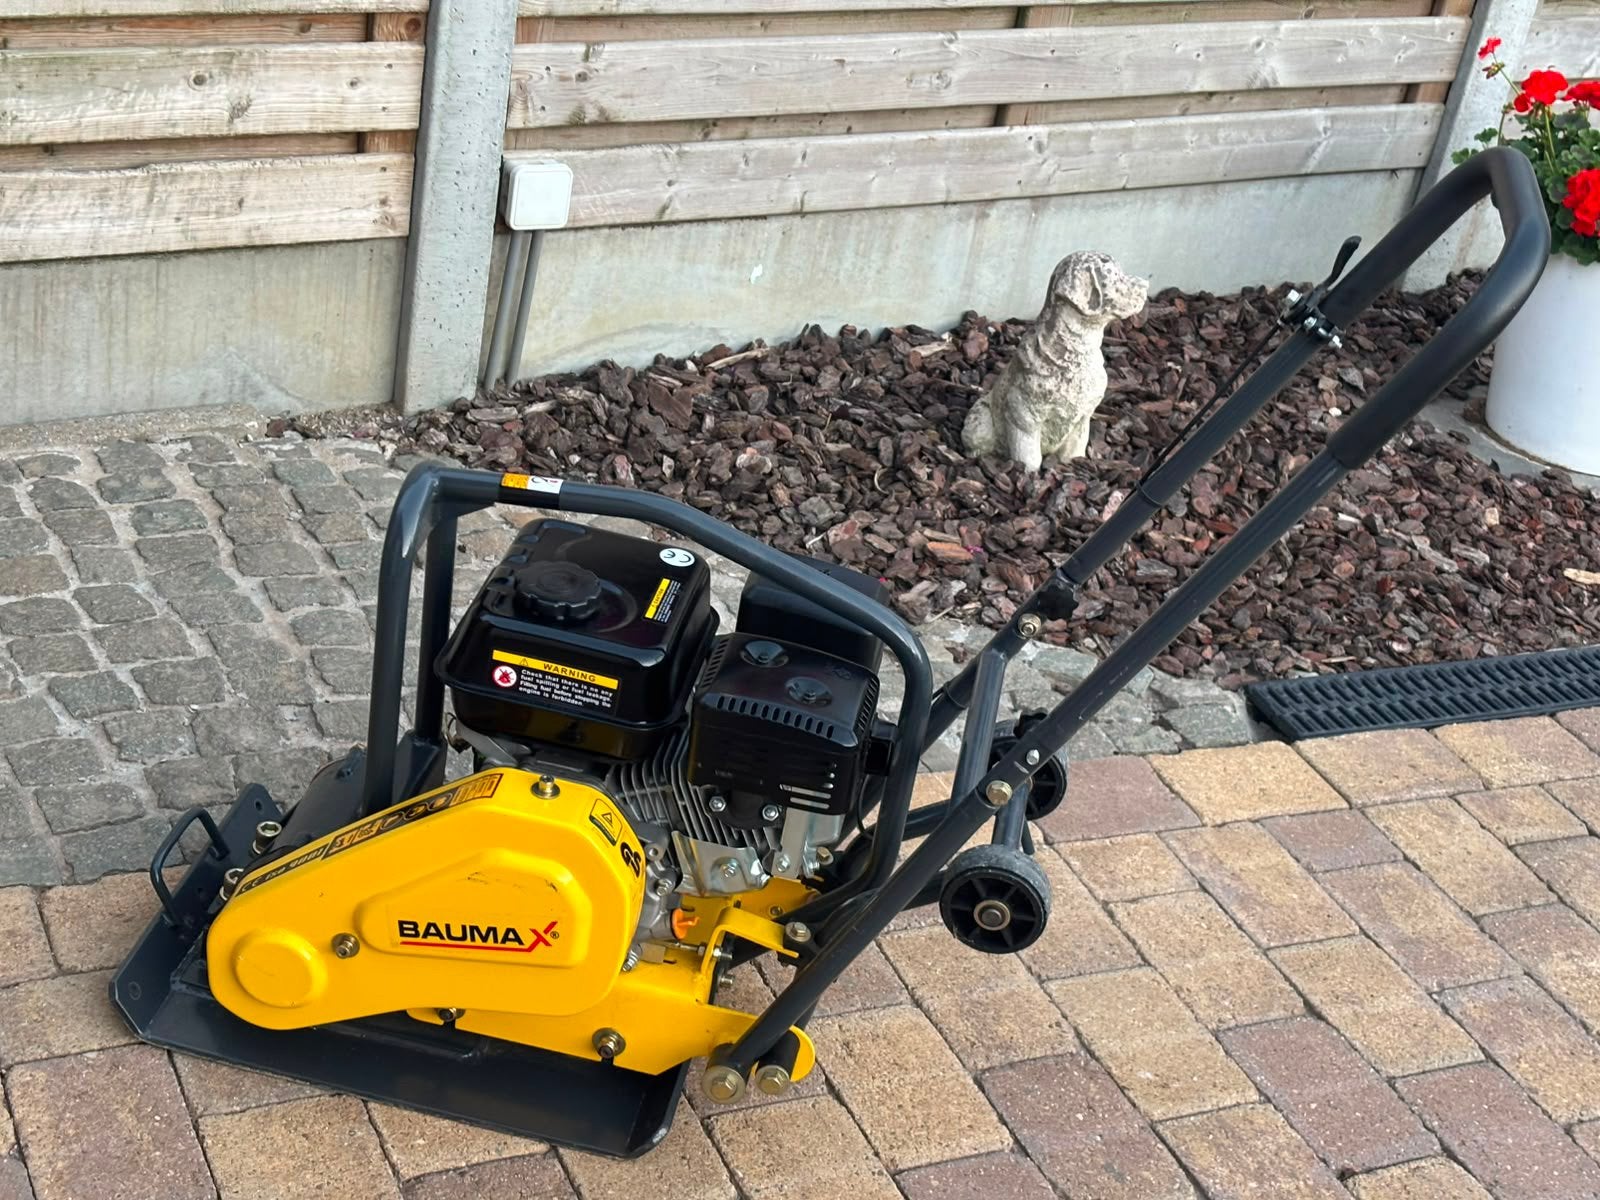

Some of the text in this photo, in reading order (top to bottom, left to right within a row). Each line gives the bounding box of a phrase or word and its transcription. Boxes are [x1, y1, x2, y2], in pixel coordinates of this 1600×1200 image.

[543, 663, 596, 682] WARNING
[518, 686, 541, 695] engine
[520, 680, 538, 690] Filling
[553, 688, 572, 698] before
[521, 669, 543, 678] Check
[545, 674, 559, 682] that
[561, 679, 579, 688] there
[601, 690, 613, 698] any
[535, 678, 560, 689] spilling
[571, 687, 585, 695] fuel
